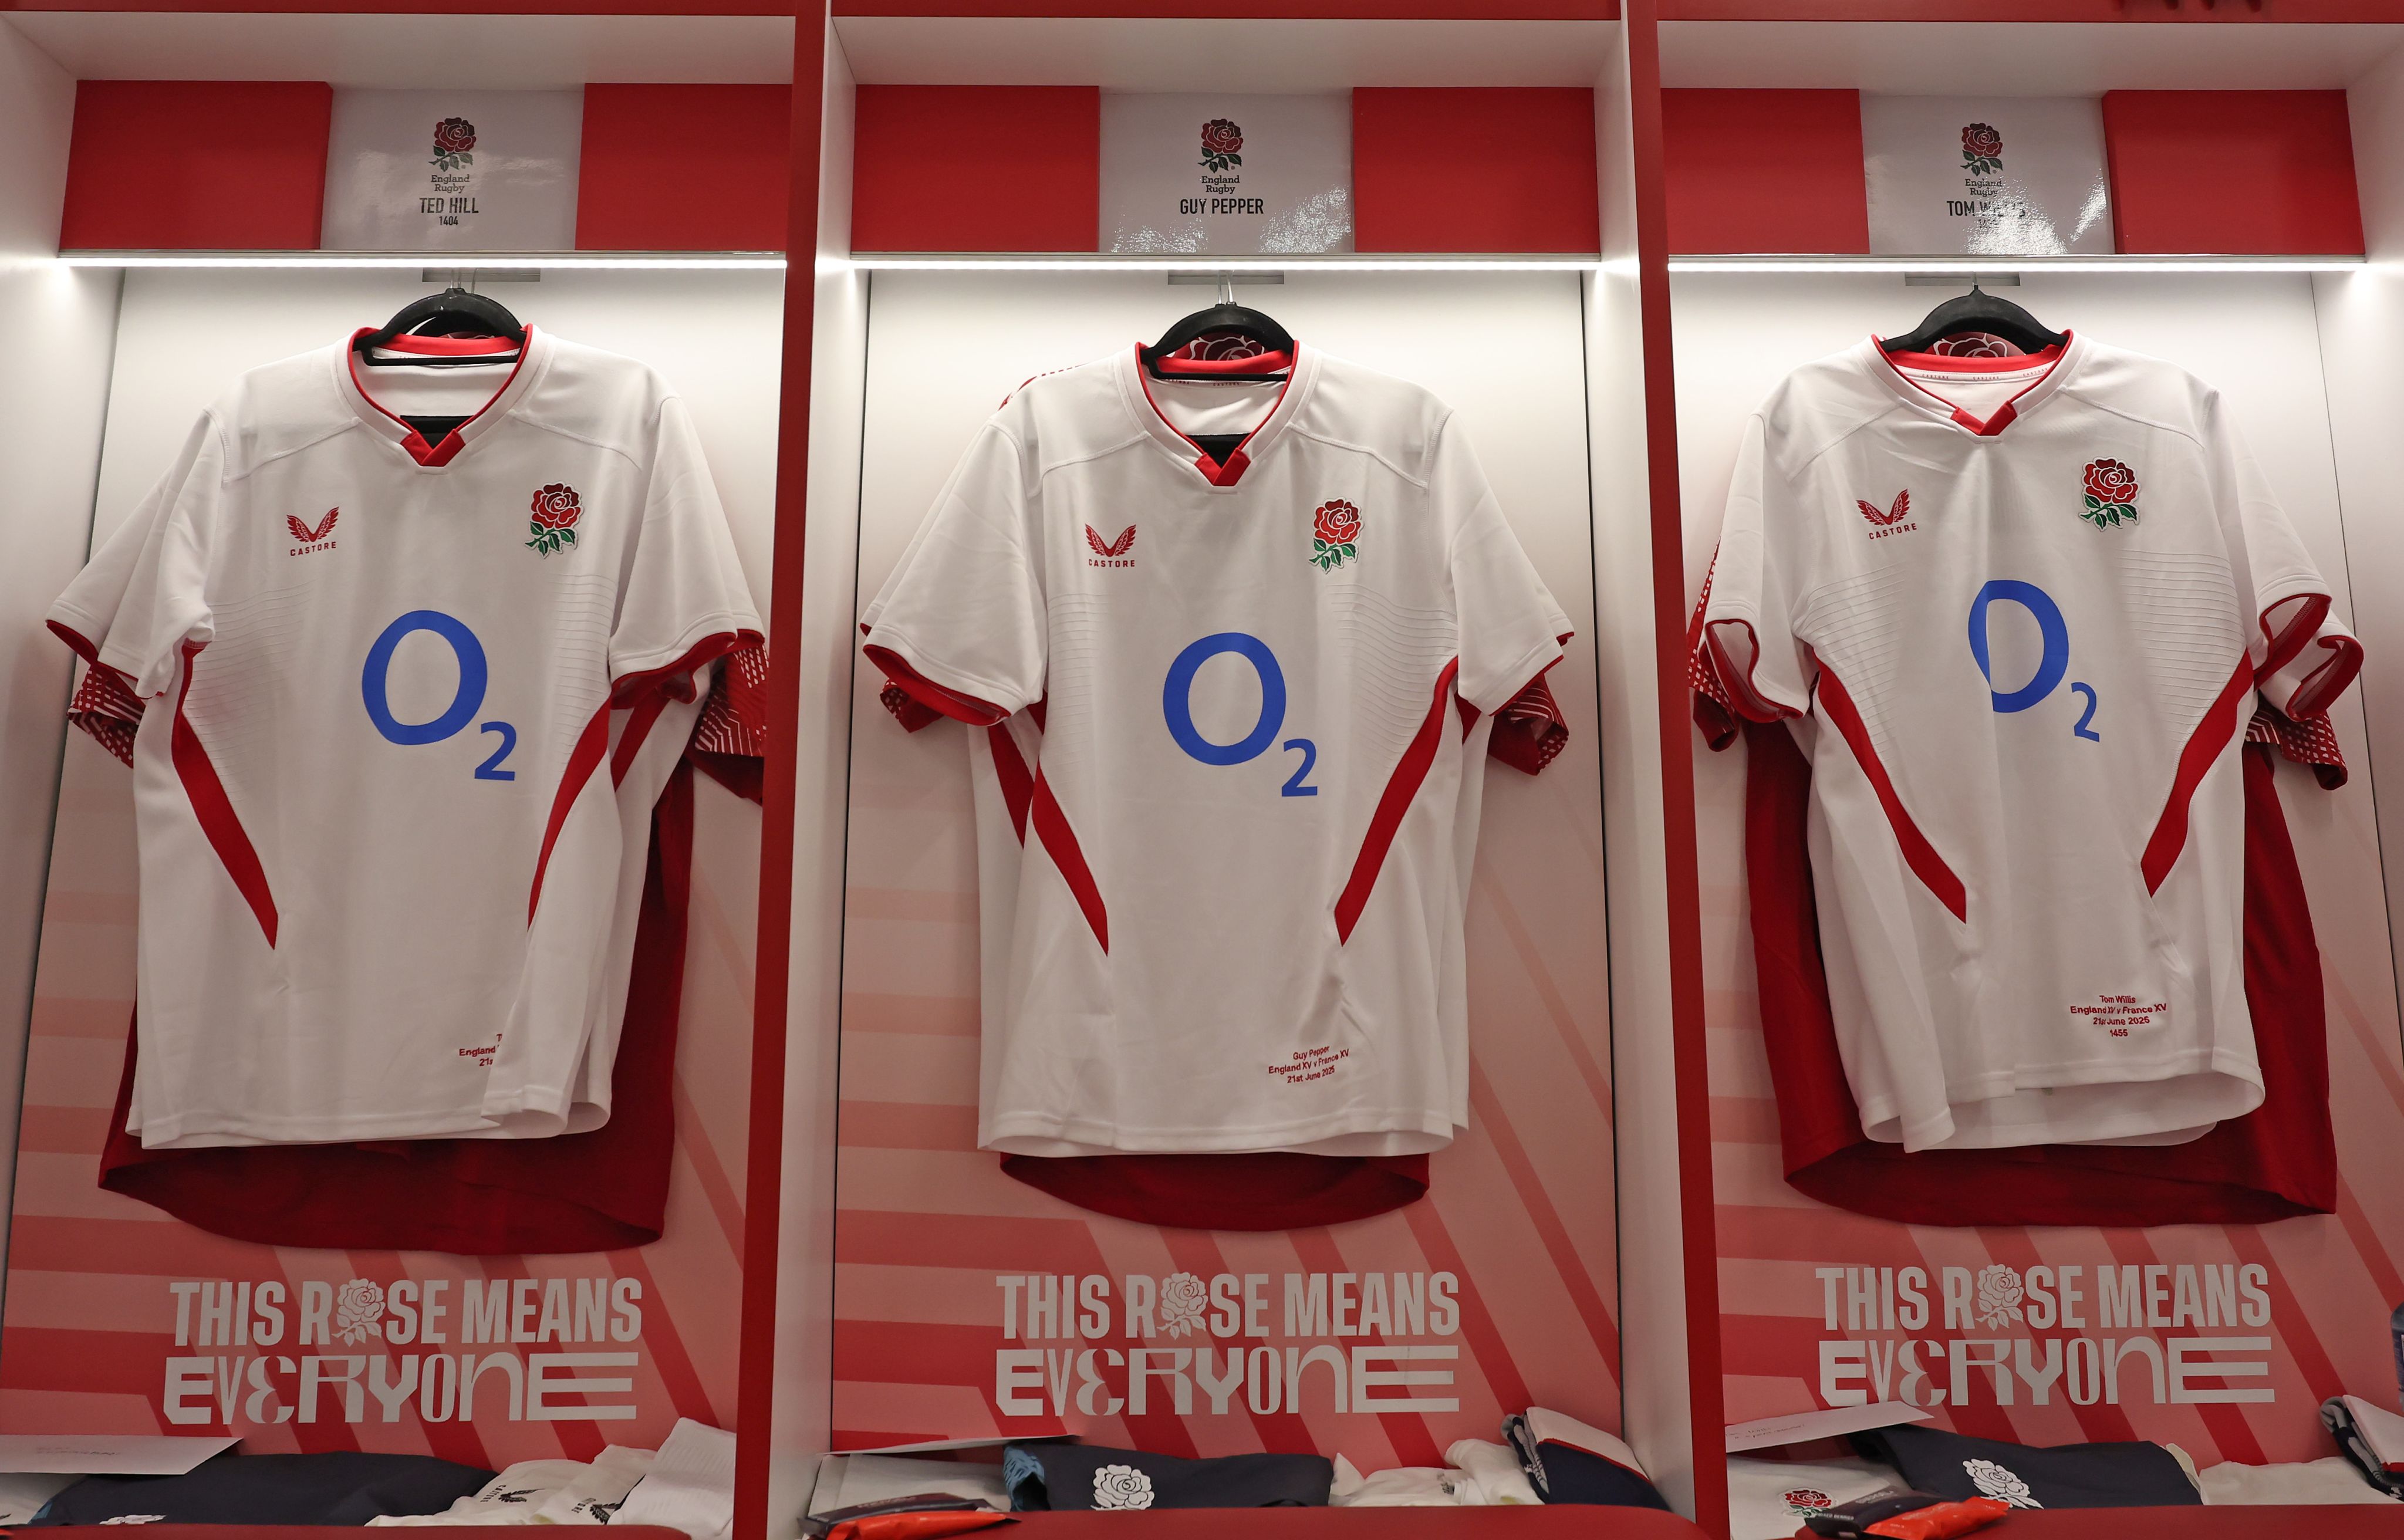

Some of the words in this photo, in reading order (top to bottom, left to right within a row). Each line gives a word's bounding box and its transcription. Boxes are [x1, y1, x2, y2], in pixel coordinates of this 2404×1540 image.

[431, 174, 470, 184] England
[1201, 175, 1240, 185] England
[1964, 178, 2003, 188] England
[434, 184, 465, 194] Rugby
[1206, 185, 1235, 194] Rugby
[1970, 188, 1998, 197] Rugby
[419, 197, 444, 214] TED
[449, 197, 479, 214] HILL
[1180, 198, 1206, 214] GUY
[1211, 198, 1264, 214] PEPPER
[1946, 201, 1976, 217] TOM
[439, 216, 459, 226] 1404
[1868, 523, 1917, 540] CASTORE
[289, 541, 337, 556] CASTORE
[1088, 559, 1136, 568] CASTORE
[2099, 995, 2115, 1004] Tom
[2115, 995, 2136, 1004] Willis
[2070, 1005, 2106, 1015] England
[2122, 1006, 2153, 1015] France
[2153, 1003, 2167, 1012] XV
[2106, 1017, 2126, 1026] June
[2128, 1016, 2150, 1025] 2025
[2109, 1029, 2129, 1038] 1455
[458, 1045, 496, 1058] England
[1293, 1051, 1308, 1061] Guy
[1309, 1046, 1330, 1058] Pepper
[479, 1058, 494, 1067] 21s
[1268, 1063, 1301, 1075] England
[1302, 1061, 1312, 1070] XV
[1318, 1053, 1339, 1067] France
[1339, 1048, 1349, 1059] XV
[1287, 1074, 1304, 1084] 21st
[1305, 1071, 1321, 1081] June
[1321, 1065, 1335, 1078] 2025
[1815, 1266, 1929, 1331] THIS
[1943, 1264, 2086, 1332] RSE
[2096, 1263, 2271, 1329] MEANS
[995, 1274, 1110, 1339] THIS
[1125, 1271, 1269, 1340] RSE
[1283, 1271, 1460, 1338] MEANS
[170, 1280, 286, 1347] THIS
[299, 1278, 450, 1348] RSE
[460, 1276, 643, 1345] MEANS
